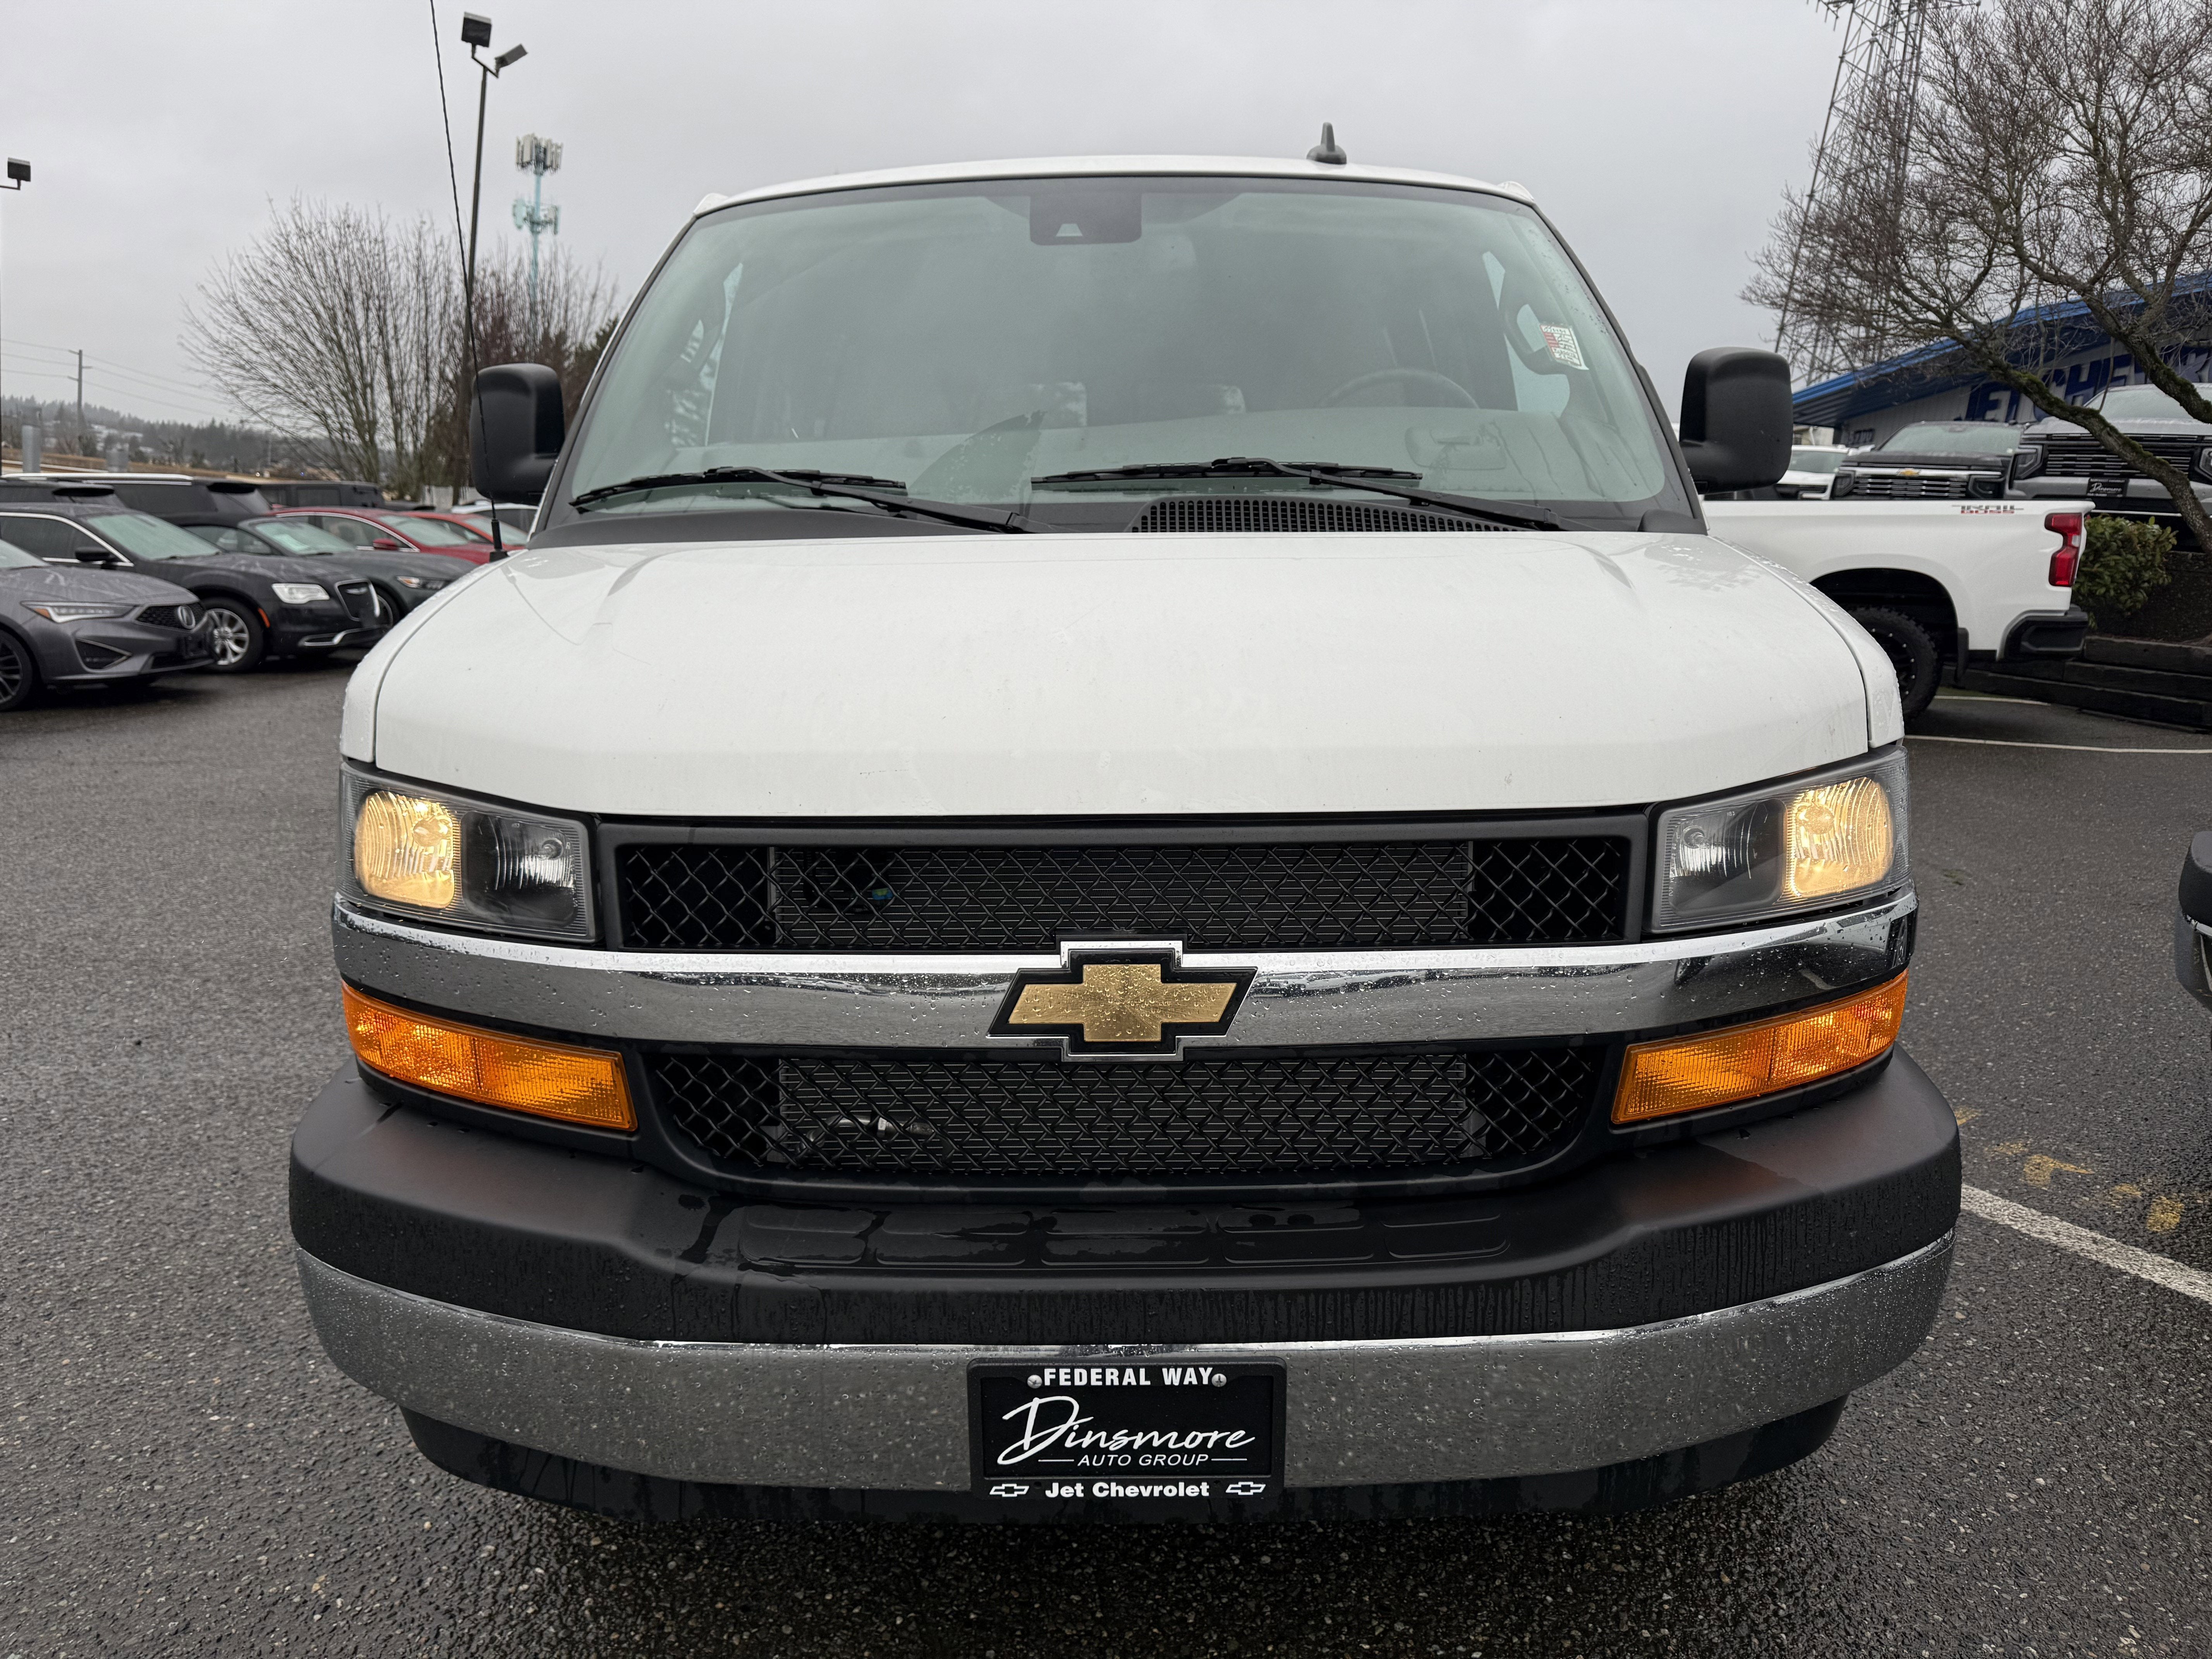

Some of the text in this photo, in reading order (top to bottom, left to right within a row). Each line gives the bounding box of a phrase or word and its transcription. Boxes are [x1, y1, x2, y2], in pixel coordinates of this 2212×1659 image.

[1044, 1367, 1213, 1386] FEDERAL WAY
[997, 1396, 1255, 1466] Dinsmore
[1077, 1454, 1209, 1467] AUTO GROUP
[1045, 1482, 1209, 1498] Jet Chevrolet
